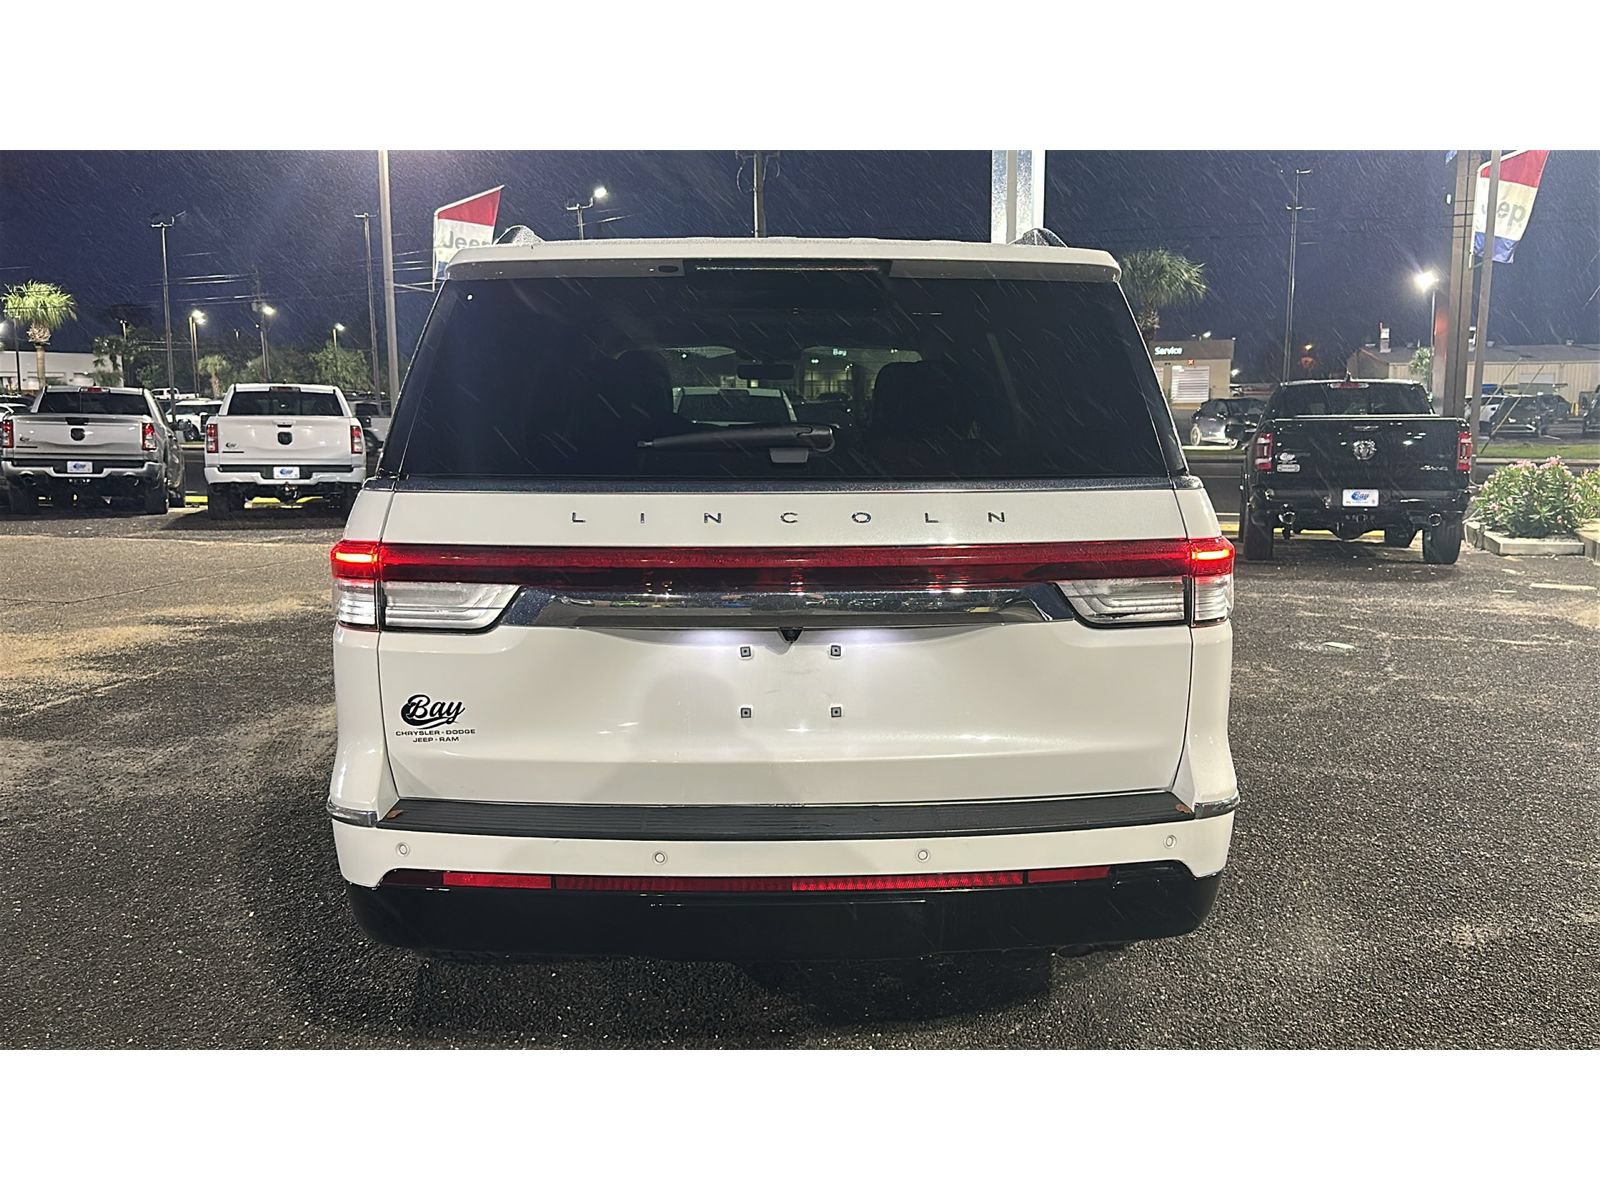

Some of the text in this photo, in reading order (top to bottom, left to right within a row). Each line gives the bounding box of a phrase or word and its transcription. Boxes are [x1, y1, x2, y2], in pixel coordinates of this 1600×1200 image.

[1154, 346, 1183, 355] Service
[571, 511, 1006, 525] LINCOLN
[401, 694, 465, 729] Bay
